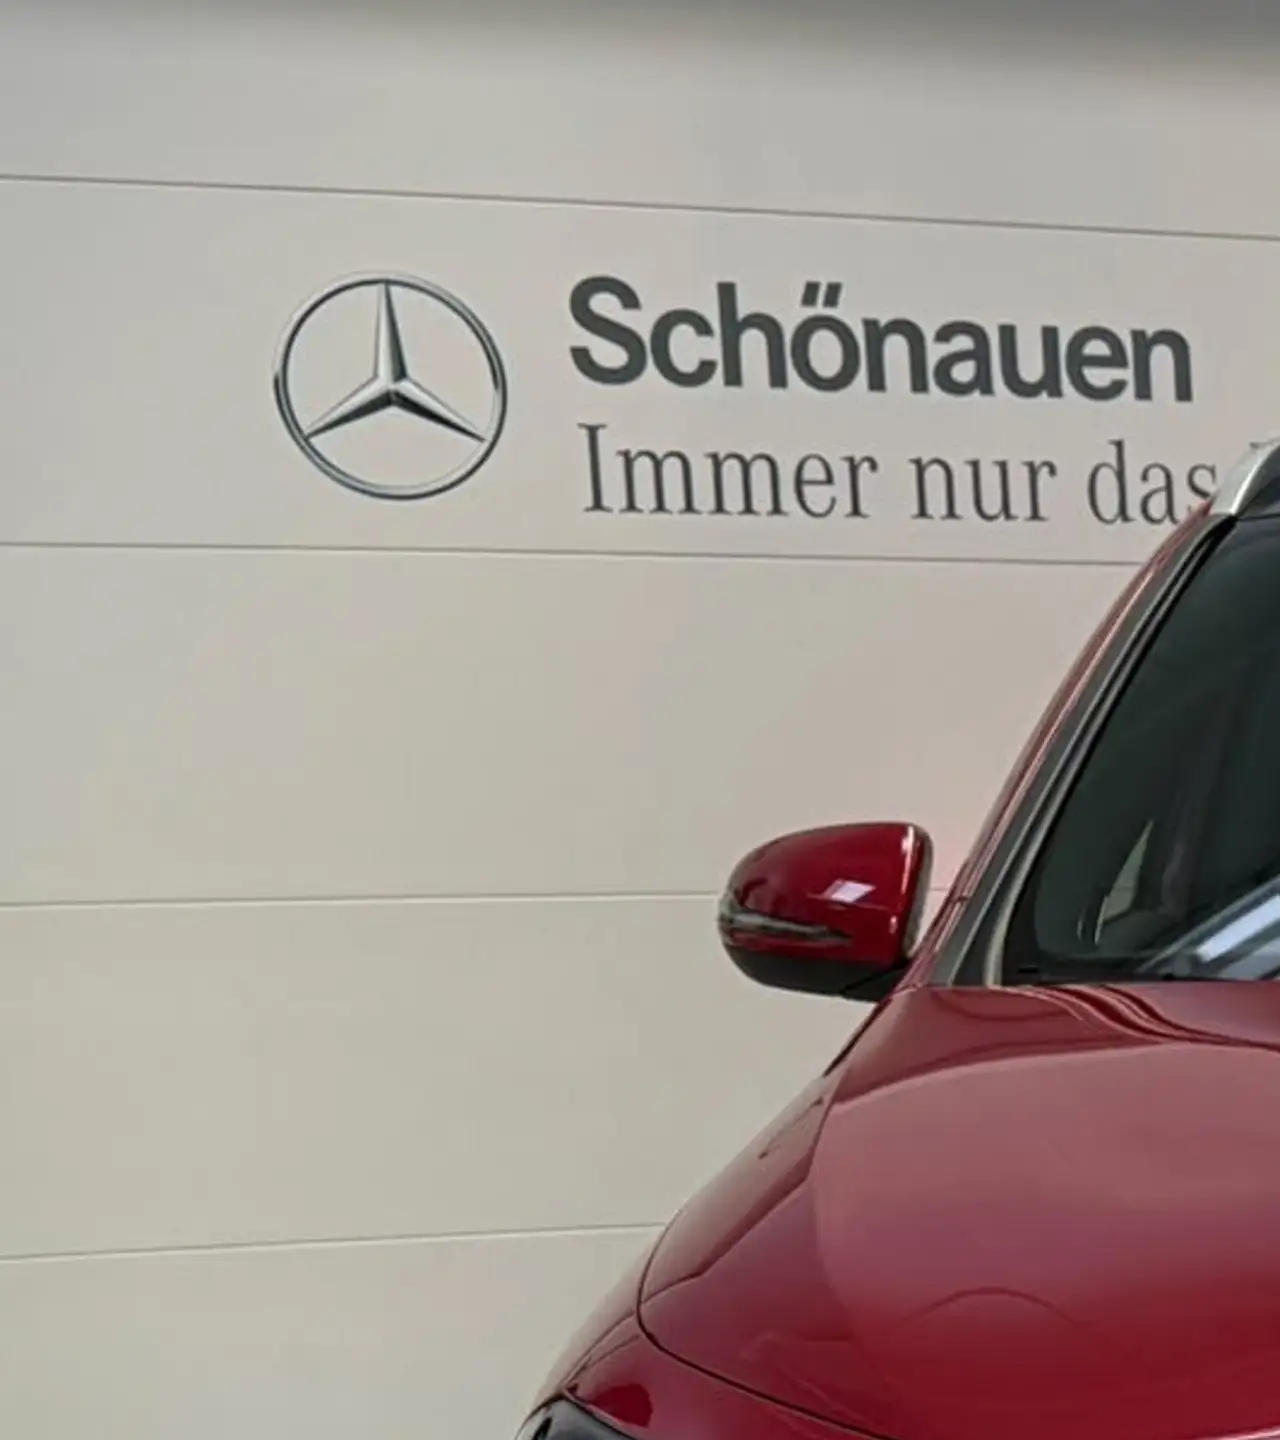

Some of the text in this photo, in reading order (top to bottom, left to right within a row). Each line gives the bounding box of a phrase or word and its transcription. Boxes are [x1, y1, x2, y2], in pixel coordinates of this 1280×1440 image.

[569, 275, 1194, 404] Schönauen
[578, 423, 1217, 526] Immer nur das
